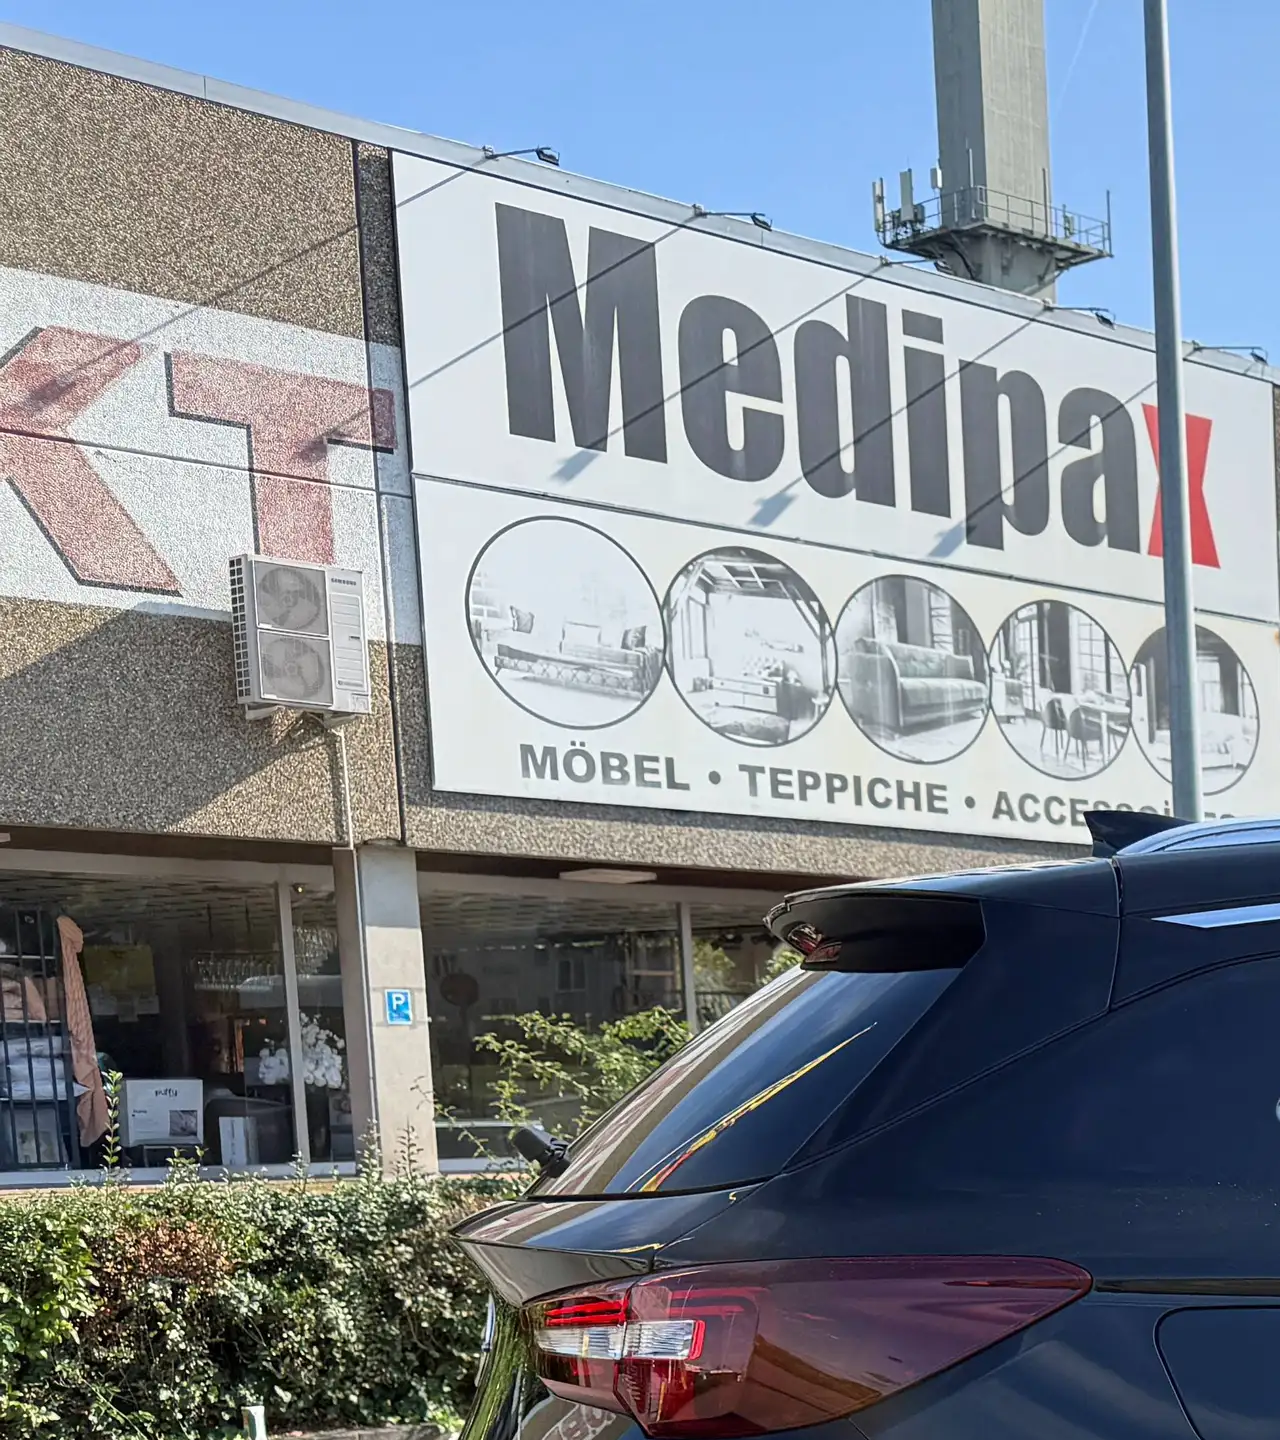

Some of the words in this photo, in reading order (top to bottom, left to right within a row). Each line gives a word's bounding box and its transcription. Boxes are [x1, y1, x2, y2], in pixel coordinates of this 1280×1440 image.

[495, 202, 1221, 569] Medipax
[520, 742, 690, 791] MÖBEL
[739, 764, 949, 815] TEPPICHE
